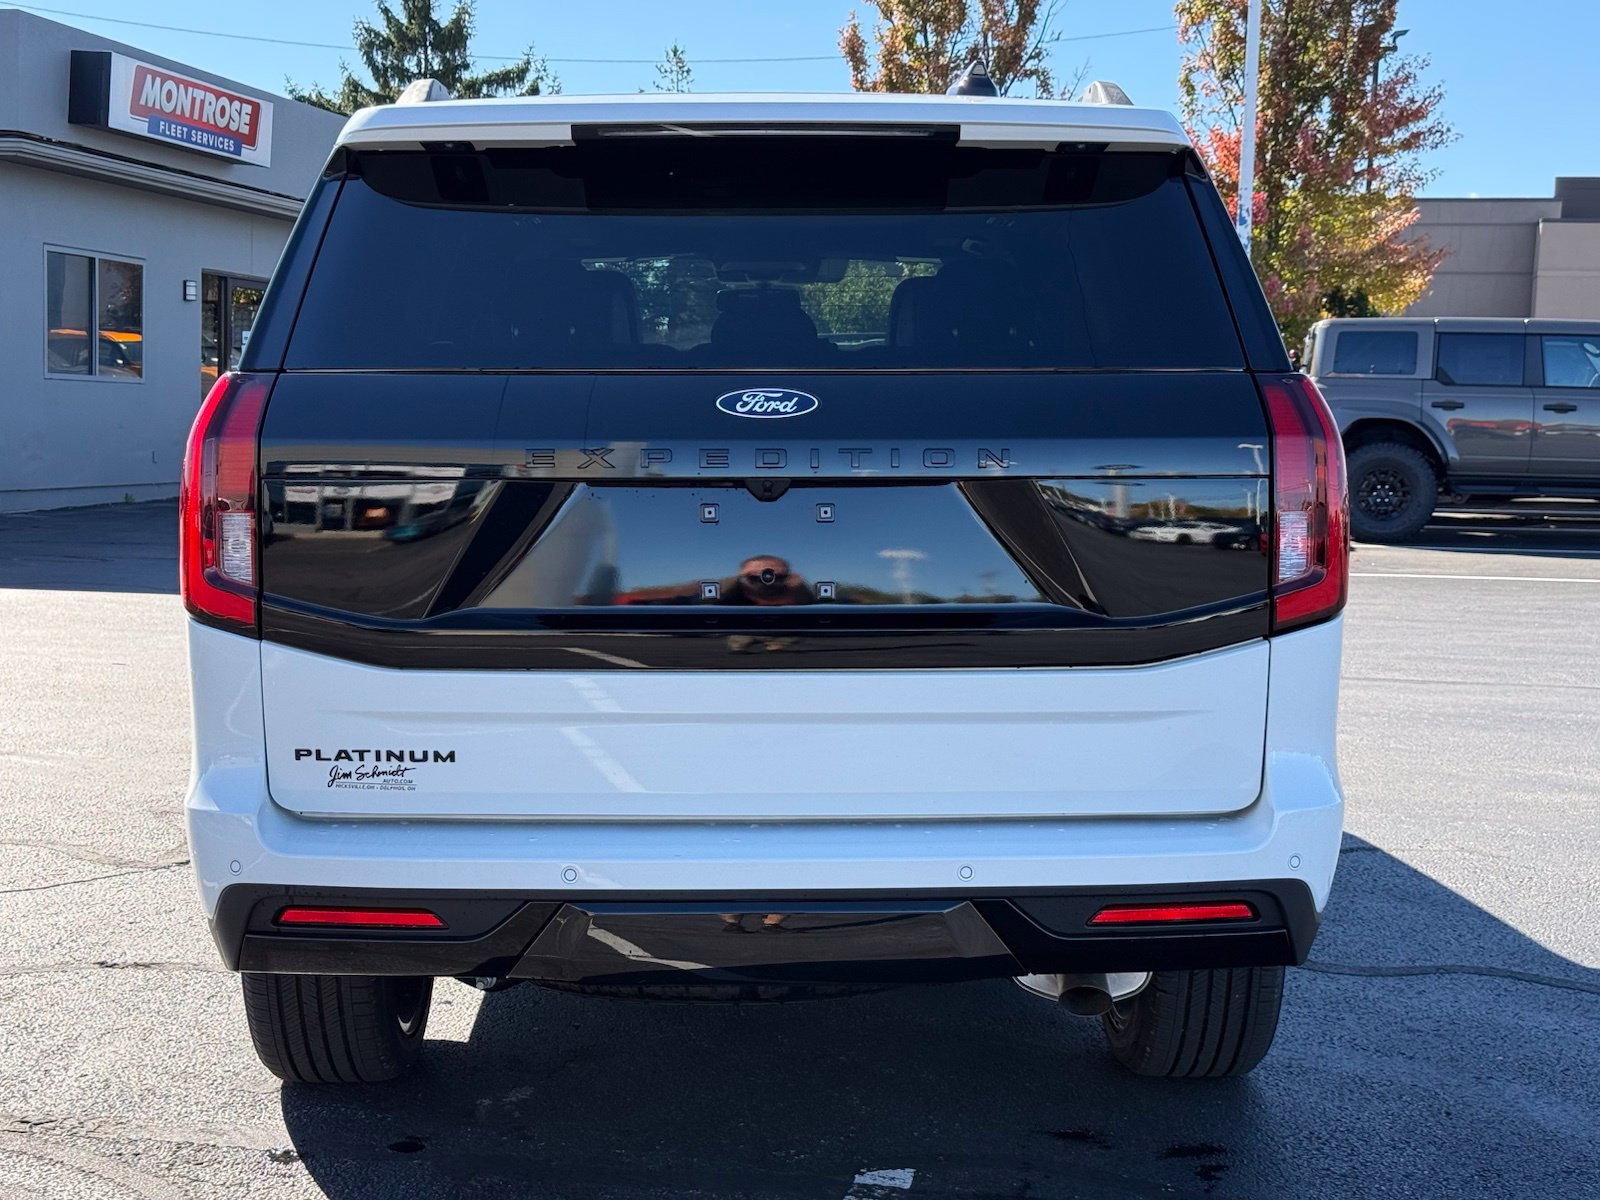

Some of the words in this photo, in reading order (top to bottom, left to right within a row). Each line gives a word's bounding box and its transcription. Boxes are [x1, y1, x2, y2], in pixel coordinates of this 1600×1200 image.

[139, 74, 252, 135] MONTROSE
[159, 121, 187, 139] FLEET
[191, 129, 235, 151] SERVICES
[735, 392, 799, 413] Ford
[525, 447, 1011, 469] EXPEDITION
[294, 748, 456, 762] PLATINUM
[328, 765, 352, 788] Jim
[354, 764, 416, 781] Schmidt
